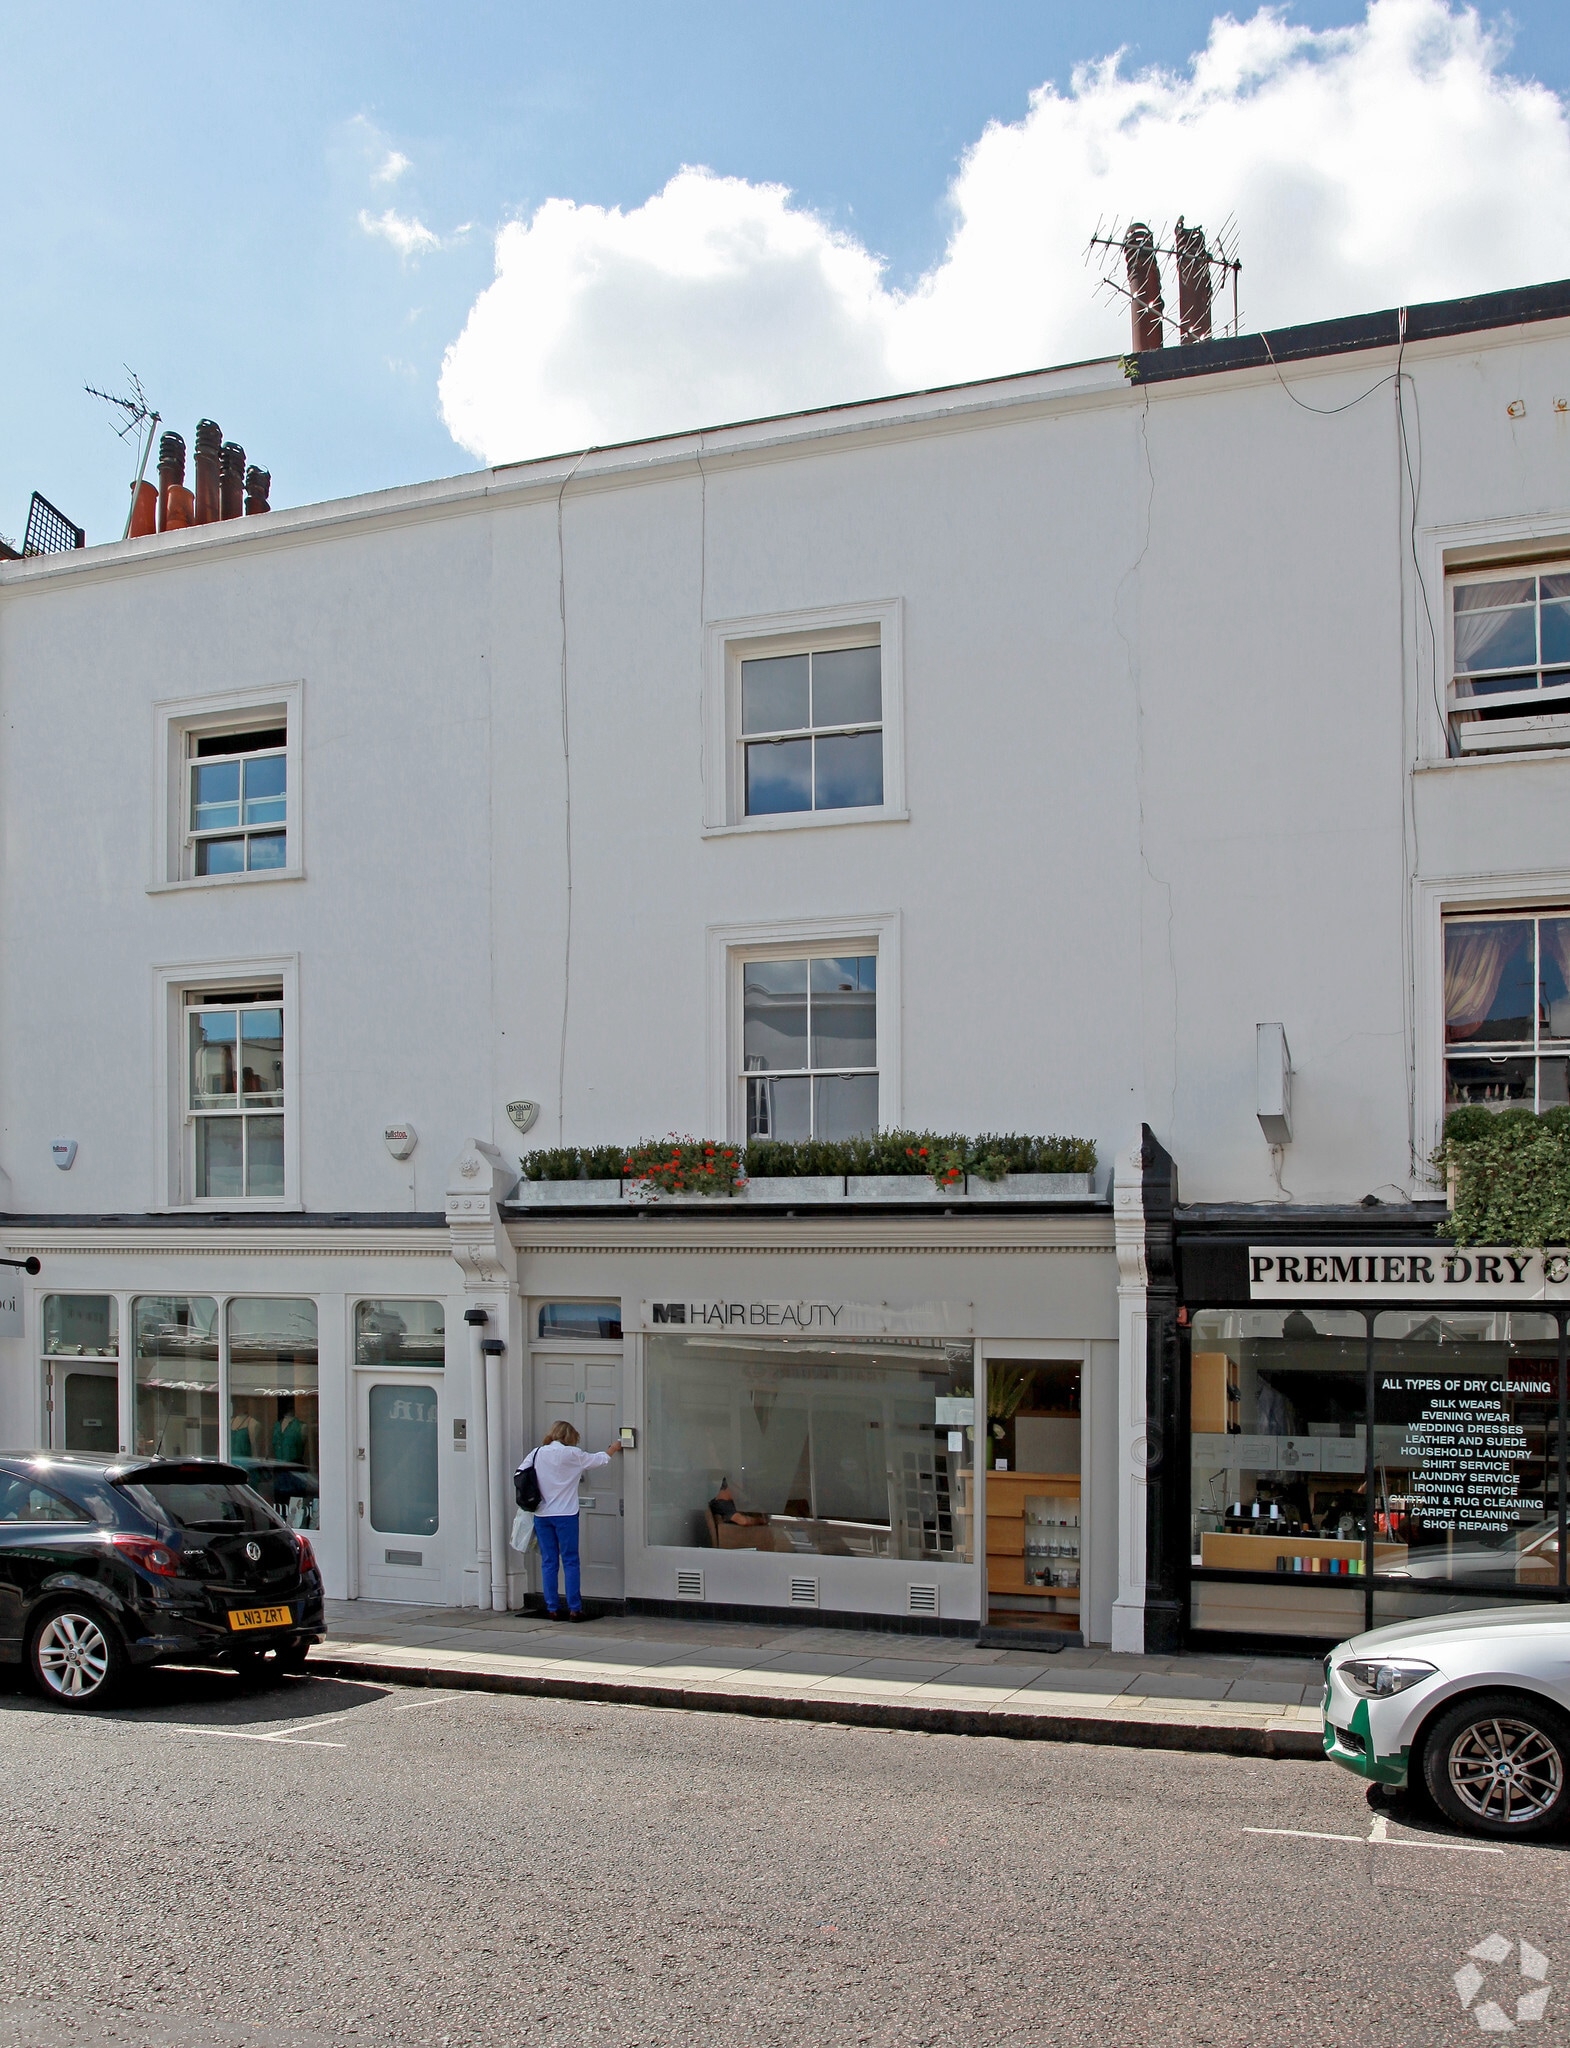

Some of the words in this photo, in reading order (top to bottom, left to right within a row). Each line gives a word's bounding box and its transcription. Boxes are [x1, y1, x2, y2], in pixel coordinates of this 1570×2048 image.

[1250, 1256, 1435, 1283] PREMIER
[1443, 1256, 1534, 1283] DRY
[1382, 1379, 1402, 1389] ALL
[1405, 1379, 1441, 1390] TYPES
[1444, 1380, 1460, 1391] OF
[1463, 1380, 1488, 1391] DRY
[1490, 1380, 1551, 1393] CLEANING
[574, 1391, 585, 1404] 10
[1430, 1399, 1456, 1408] SILK
[1459, 1400, 1501, 1409] WEARS
[1421, 1411, 1472, 1421] EVENING
[1476, 1412, 1510, 1422] WEAR
[1408, 1423, 1464, 1432] WEDDING
[1467, 1424, 1524, 1434] DRESSES
[1405, 1435, 1455, 1444] LEATHER
[1458, 1436, 1483, 1445] AND
[1486, 1437, 1527, 1447] SUEDE
[1400, 1447, 1473, 1457] HOUSEHOLD
[1476, 1449, 1532, 1459] LAUNDRY
[1422, 1460, 1456, 1469] SHIRT
[1459, 1461, 1510, 1470] SERVICE
[1412, 1472, 1466, 1481] LAUNDRY
[1469, 1473, 1520, 1483] SERVICE
[1414, 1484, 1464, 1493] IRONING
[1467, 1485, 1518, 1495] SERVICE
[1442, 1496, 1451, 1505] &
[1454, 1497, 1480, 1506] RUG
[1483, 1498, 1544, 1508] CLEANING
[1412, 1508, 1457, 1517] CARPET
[1460, 1509, 1520, 1520] CLEANING
[1422, 1520, 1455, 1529] SHOE
[1459, 1521, 1508, 1531] REPAIRS
[236, 1610, 262, 1627] LN13
[264, 1608, 284, 1623] ZRT
